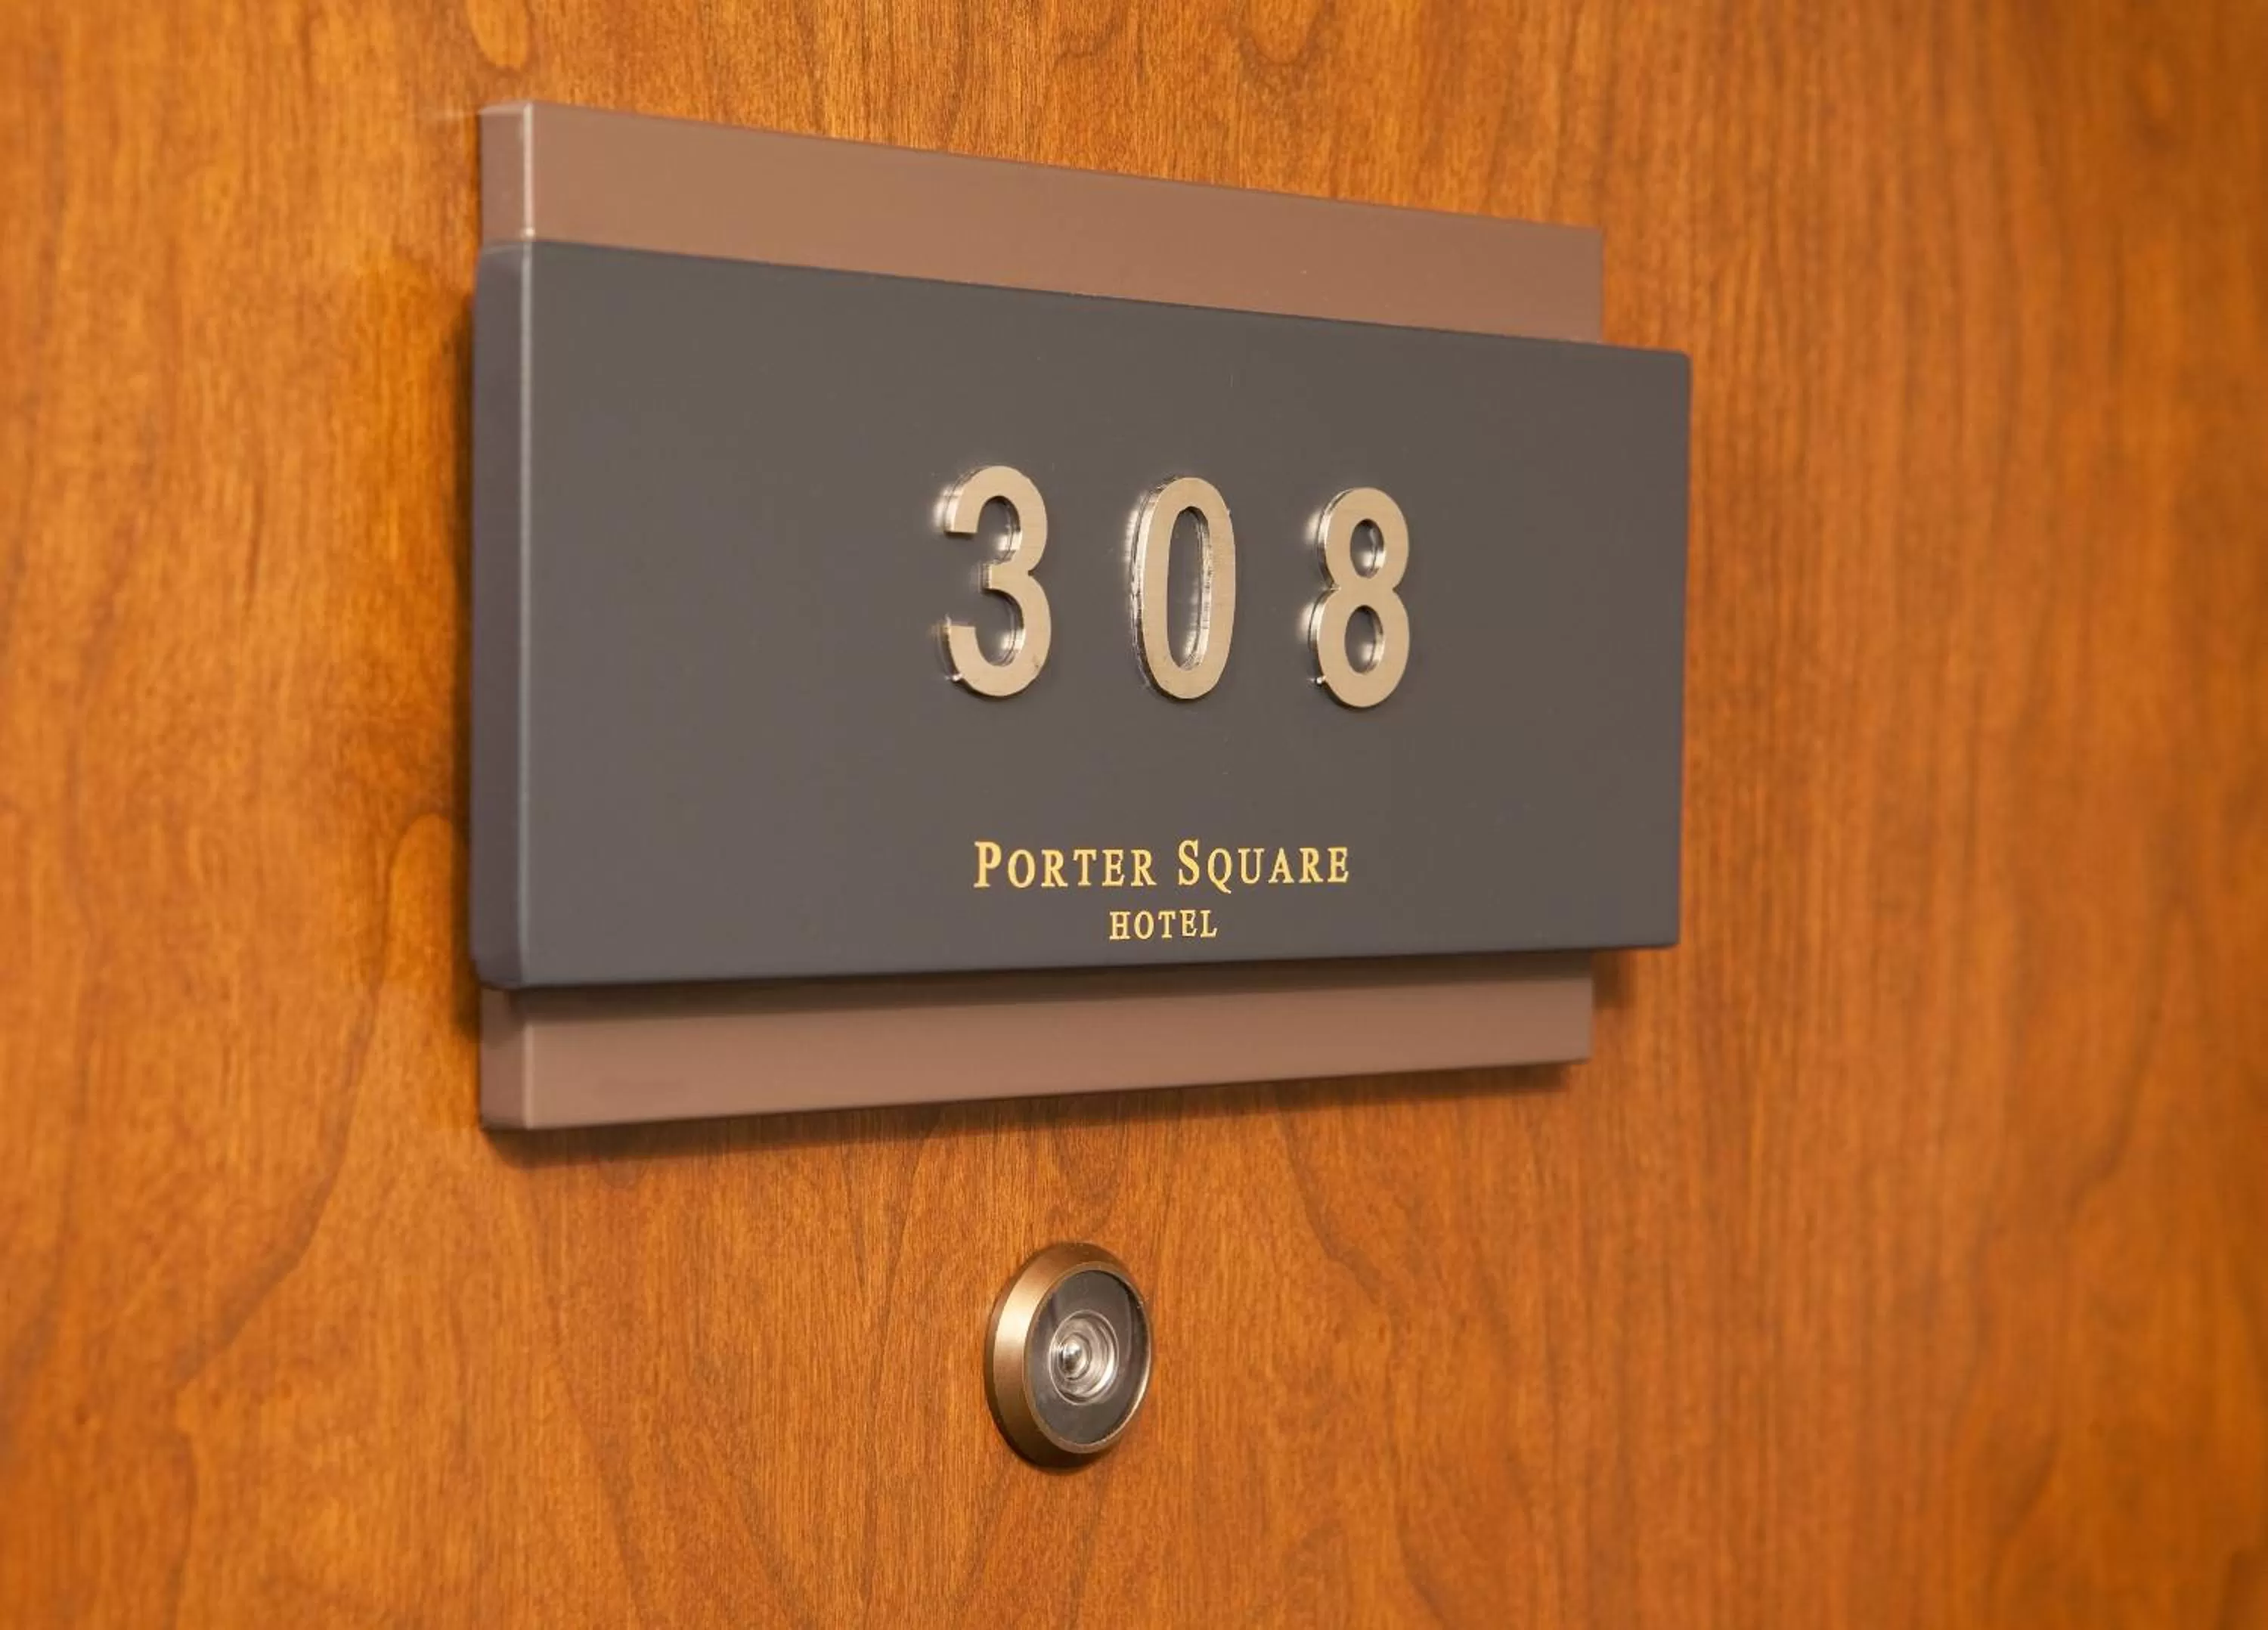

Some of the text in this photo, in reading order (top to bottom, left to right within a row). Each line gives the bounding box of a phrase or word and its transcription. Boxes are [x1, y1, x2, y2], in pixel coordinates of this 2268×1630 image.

[940, 464, 1411, 708] 308
[973, 838, 1350, 894] PORTER SQUARE
[1108, 909, 1218, 942] HOTEL
